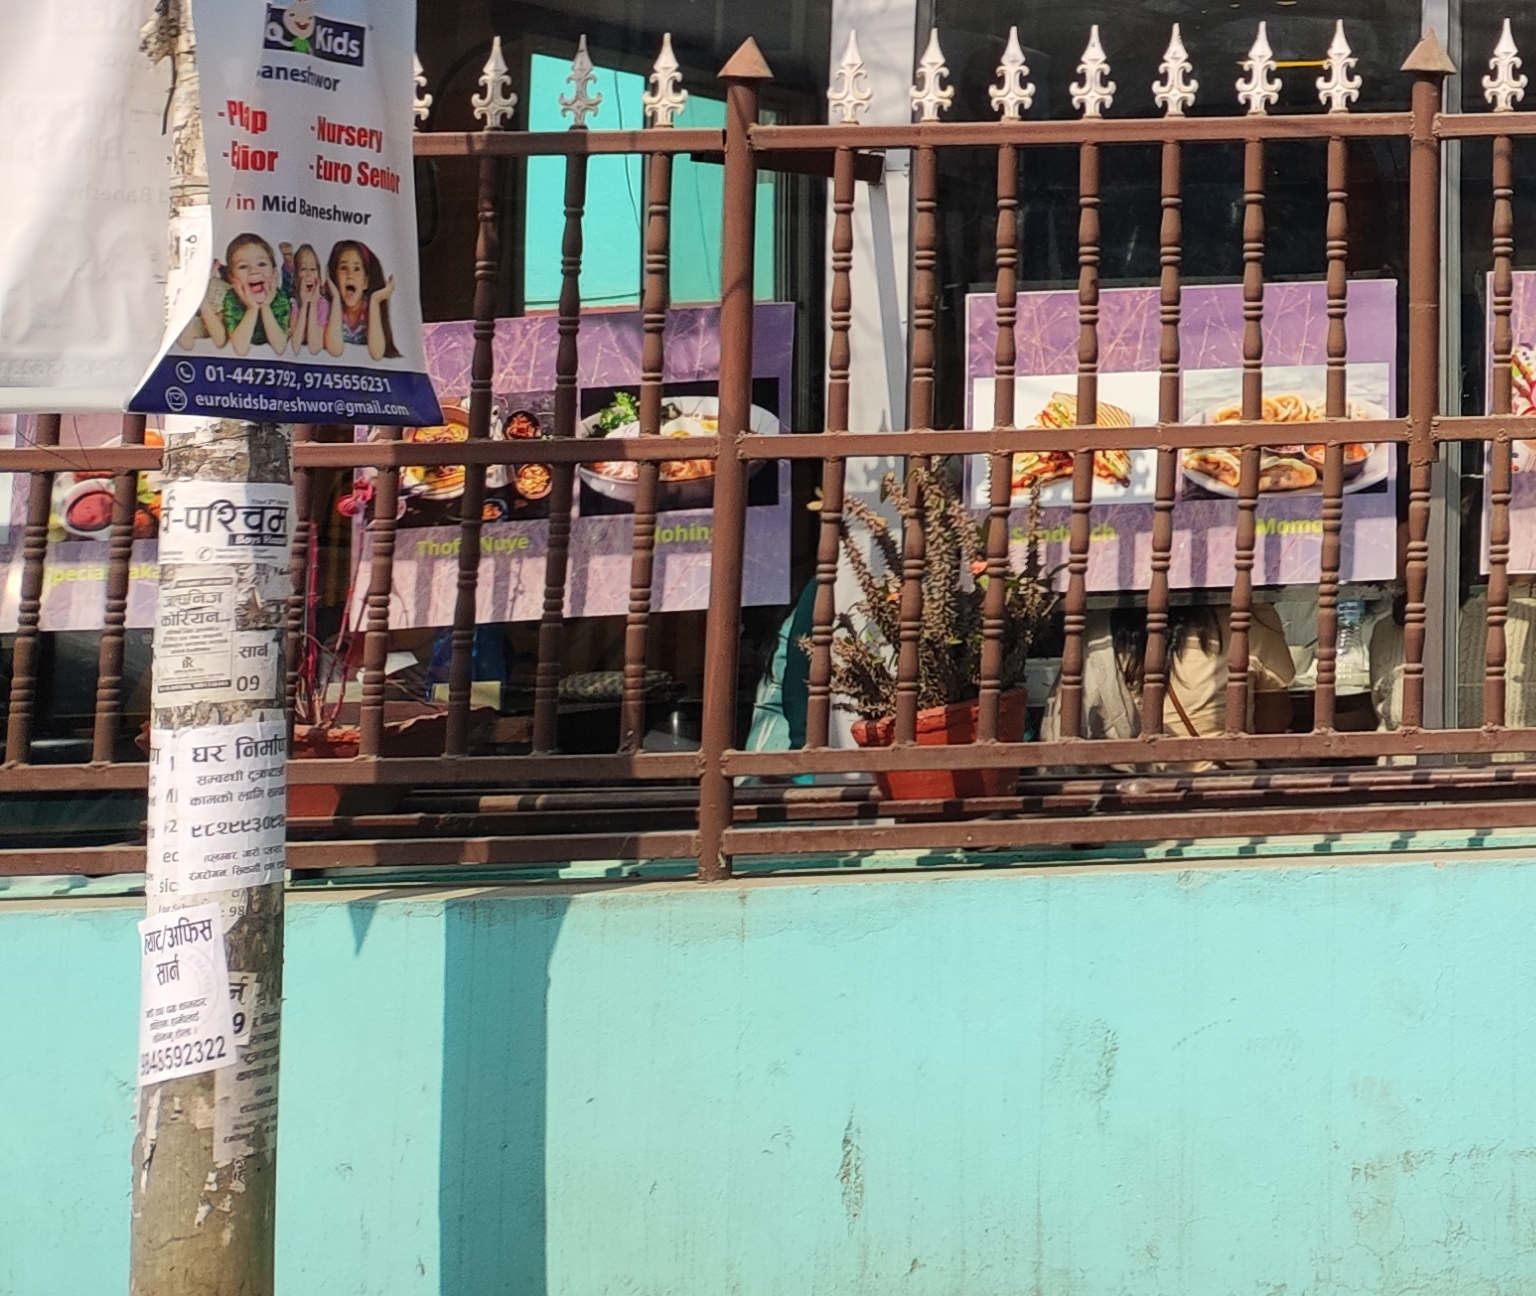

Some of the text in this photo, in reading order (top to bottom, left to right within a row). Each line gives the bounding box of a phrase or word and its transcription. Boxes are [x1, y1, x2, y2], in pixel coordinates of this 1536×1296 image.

[257, 64, 341, 92] aneshwor
[357, 161, 401, 194] Senior
[262, 194, 296, 214] Mid
[300, 198, 372, 225] Baneshwor
[304, 371, 391, 393] 9745656231
